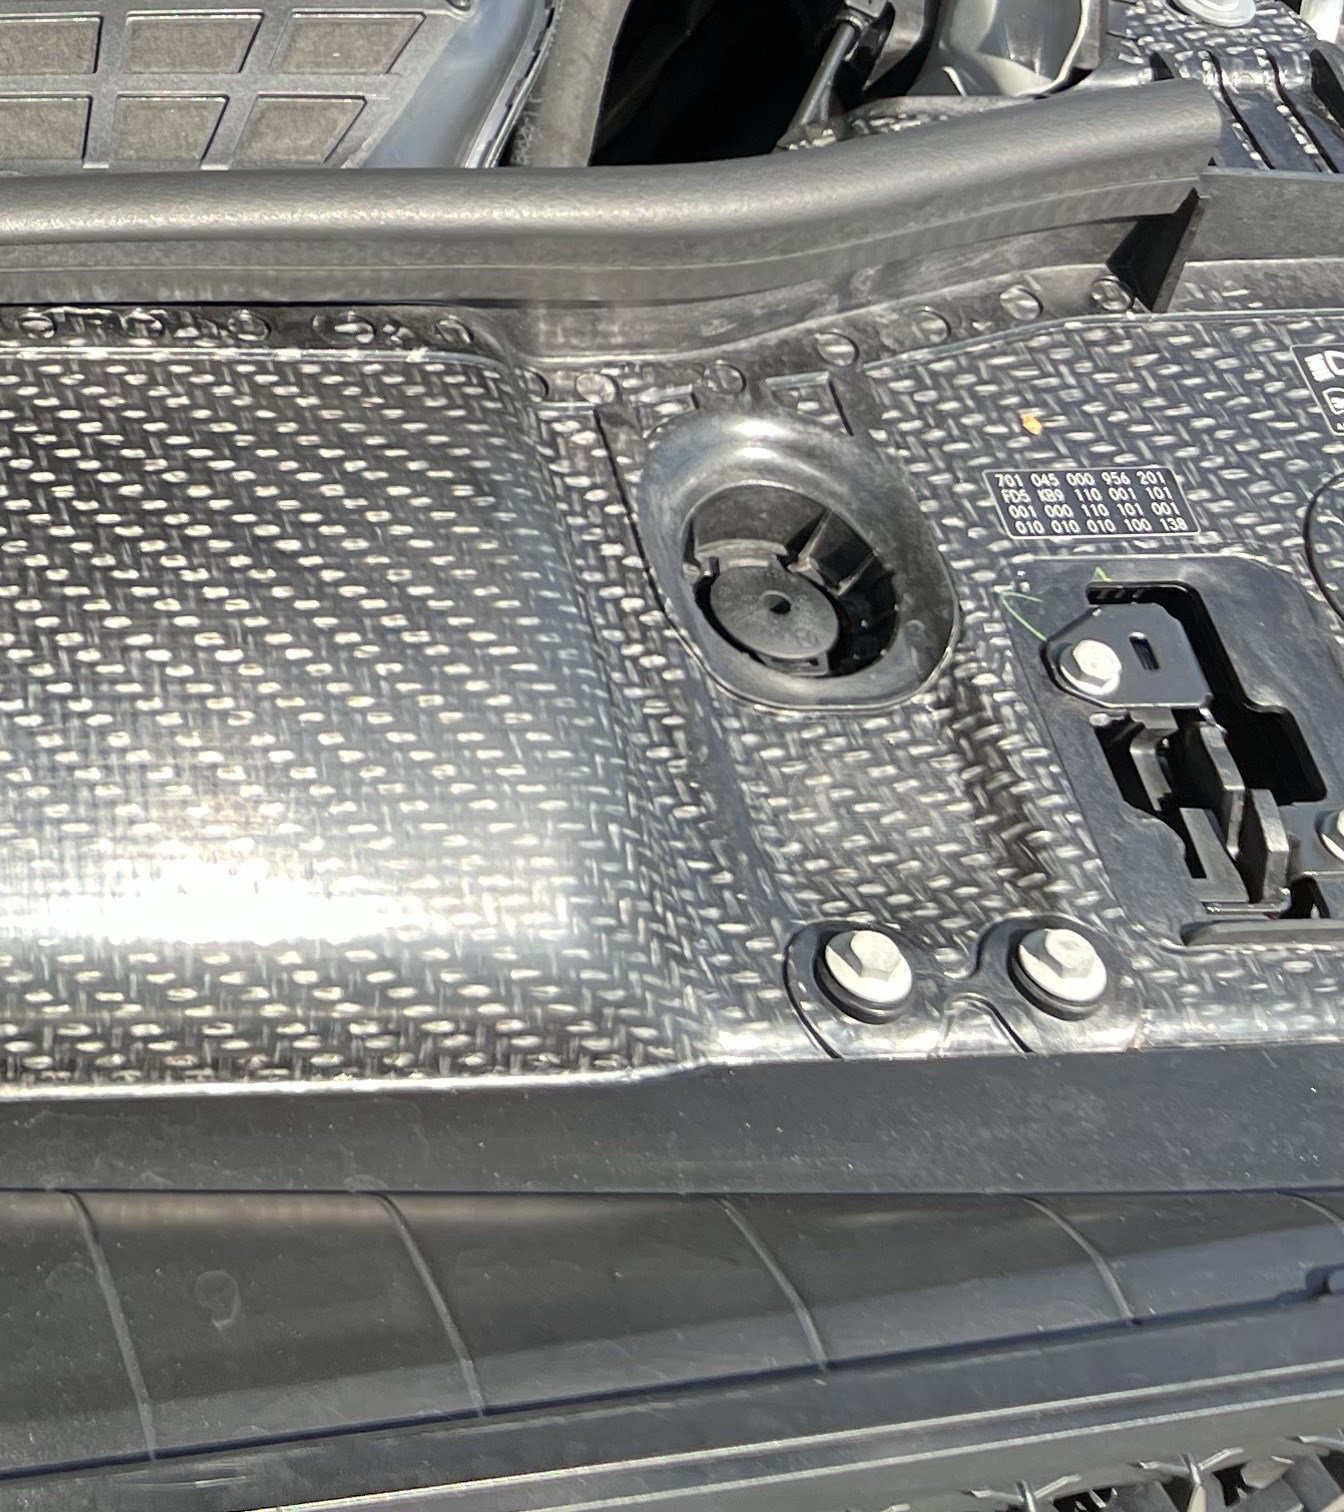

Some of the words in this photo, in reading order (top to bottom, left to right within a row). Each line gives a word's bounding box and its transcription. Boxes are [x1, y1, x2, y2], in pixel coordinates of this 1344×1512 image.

[995, 473, 1023, 488] 701
[1030, 472, 1060, 487] 045
[1066, 472, 1095, 487] 000
[1101, 471, 1131, 485] 956
[1137, 470, 1166, 485] 201
[1001, 489, 1031, 503] FD5
[1037, 489, 1065, 503] KB9
[1074, 488, 1102, 502] 110
[1109, 487, 1137, 501] 001
[1145, 486, 1173, 500] 101
[1008, 505, 1037, 519] 001
[1044, 504, 1074, 518] 000
[1081, 504, 1110, 517] 110
[1117, 503, 1144, 516] 101
[1151, 502, 1181, 516] 001
[1015, 520, 1045, 534] 010
[1051, 520, 1081, 534] 010
[1086, 519, 1116, 533] 010
[1124, 519, 1153, 532] 100
[1159, 517, 1189, 531] 138
